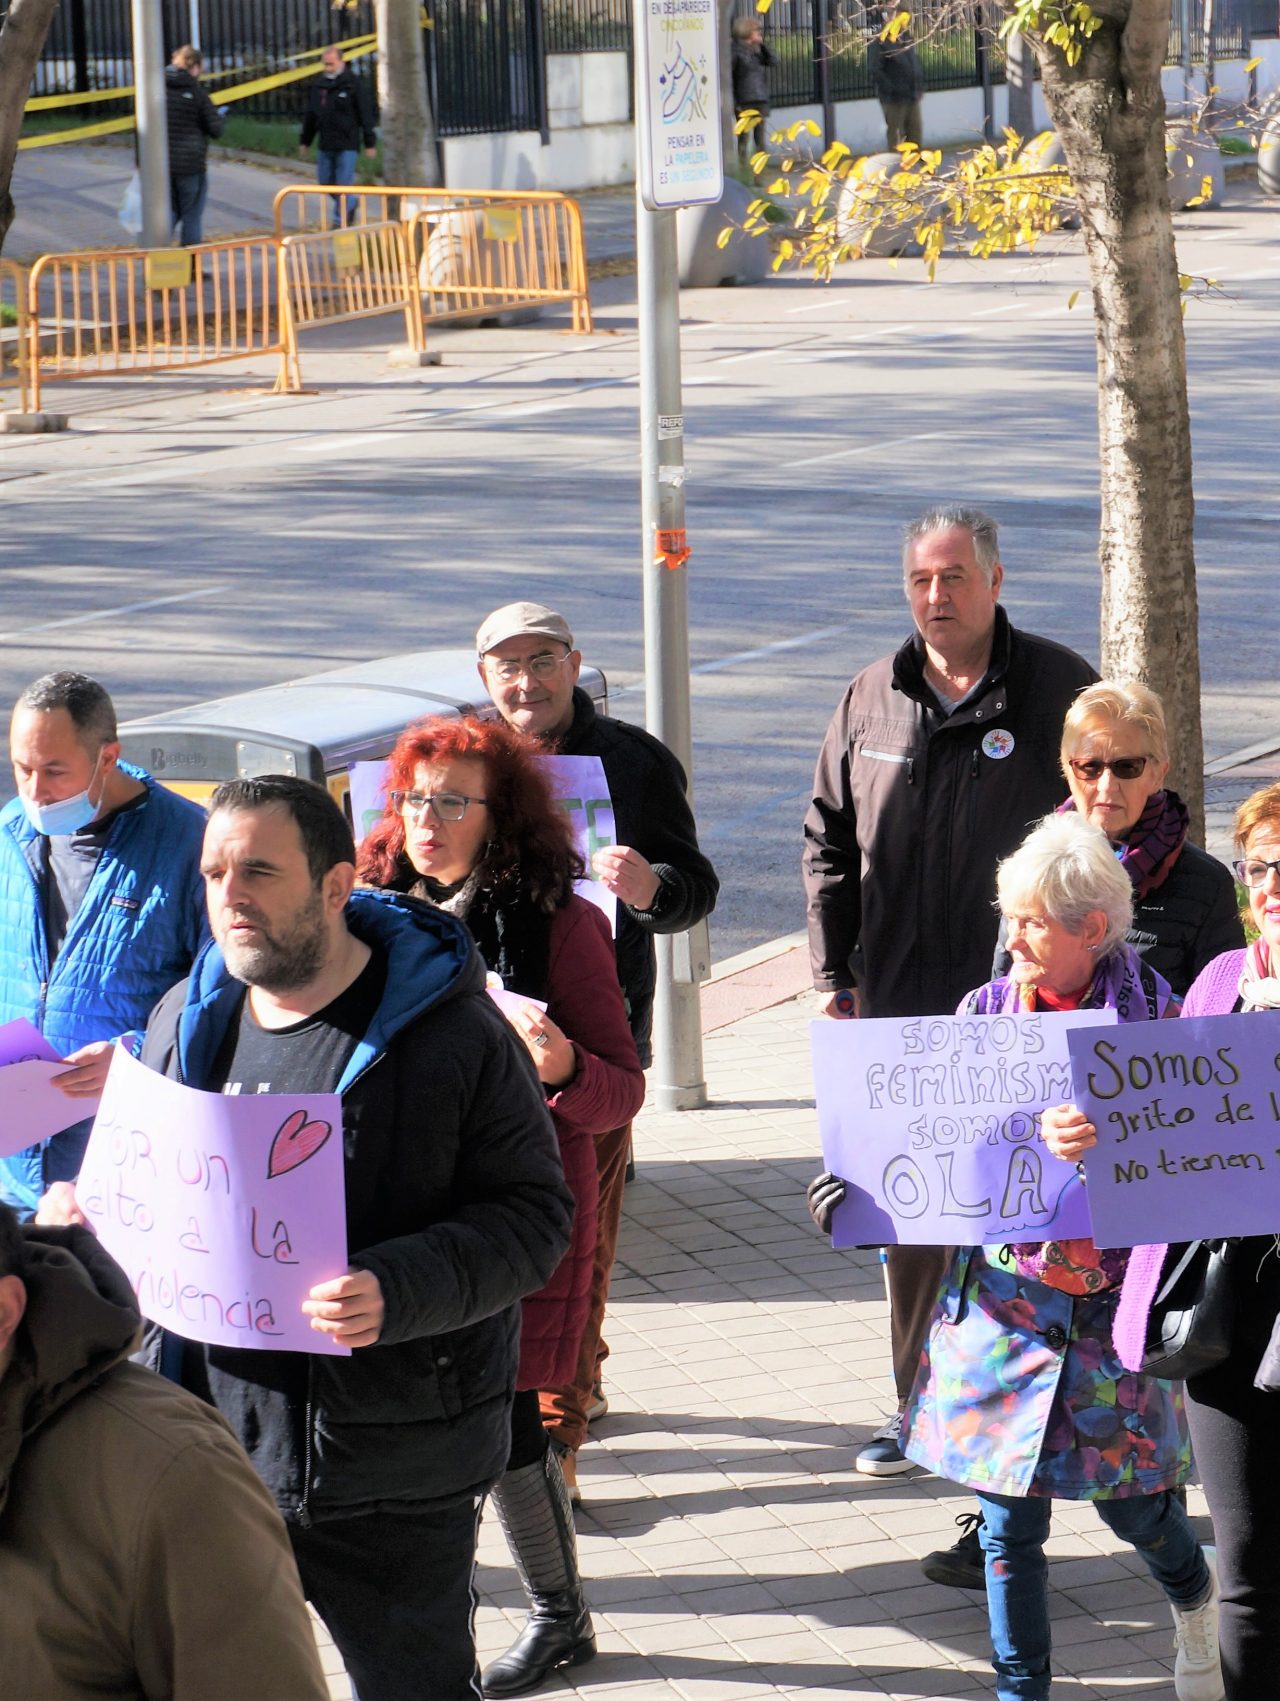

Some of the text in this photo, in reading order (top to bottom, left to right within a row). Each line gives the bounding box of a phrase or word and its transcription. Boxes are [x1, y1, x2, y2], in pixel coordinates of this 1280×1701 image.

[667, 133, 705, 149] PENSAR EN
[661, 416, 683, 429] REFO
[901, 1016, 1045, 1055] SOMOS
[1087, 1038, 1241, 1101] Somos
[908, 1108, 1044, 1150] SOMO
[1108, 1098, 1196, 1143] grito
[1215, 1093, 1255, 1125] de
[882, 1145, 1049, 1219] OLA
[1113, 1162, 1149, 1185] No
[1157, 1148, 1265, 1177] tienen
[84, 1171, 154, 1232] alto
[178, 1216, 210, 1254] a
